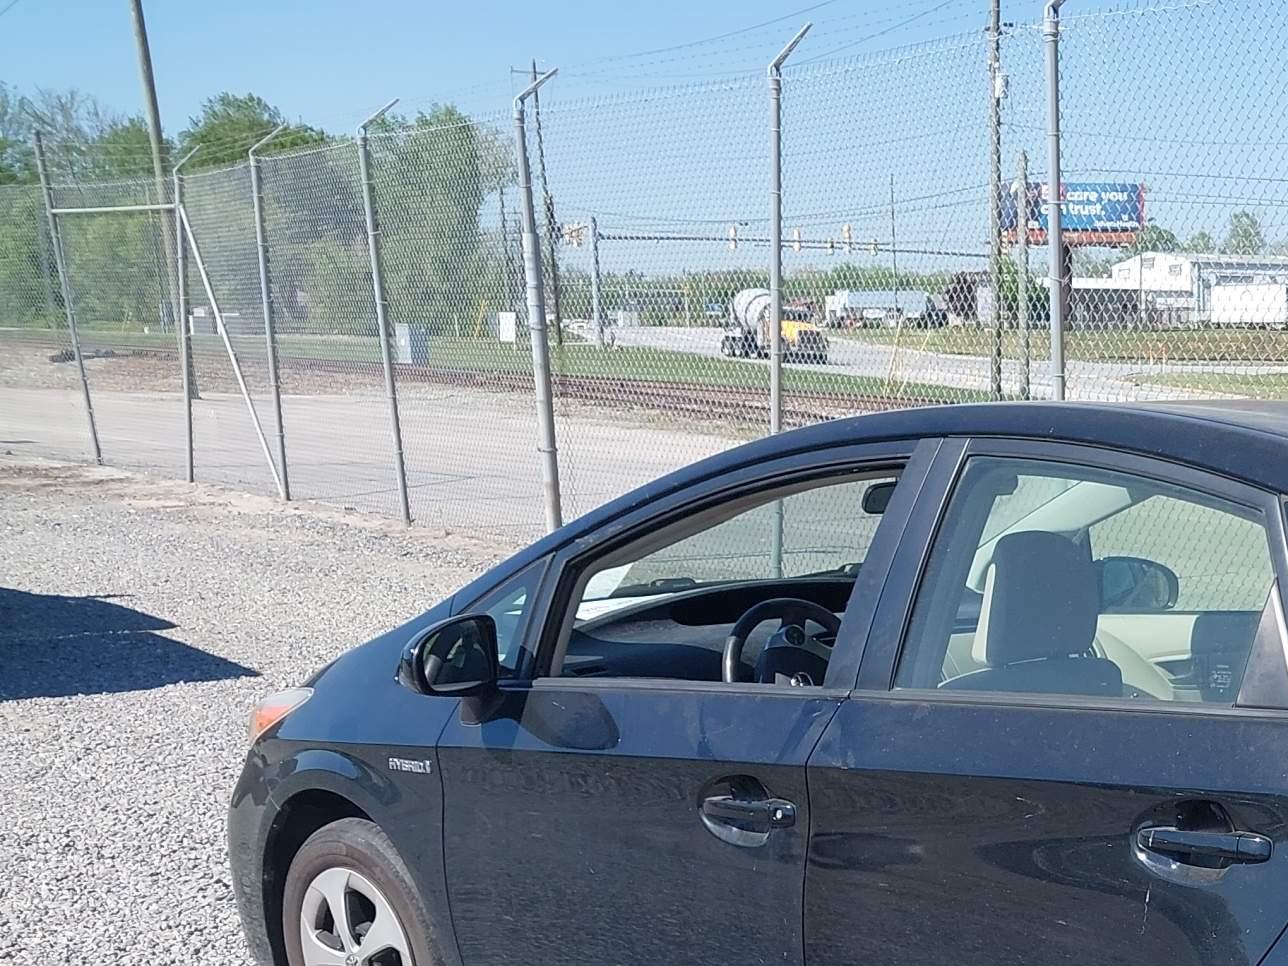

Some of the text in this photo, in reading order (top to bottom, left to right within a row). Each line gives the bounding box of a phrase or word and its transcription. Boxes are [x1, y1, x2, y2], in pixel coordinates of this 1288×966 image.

[1066, 191, 1098, 201] care
[1102, 191, 1128, 205] you
[1040, 203, 1066, 215] cn
